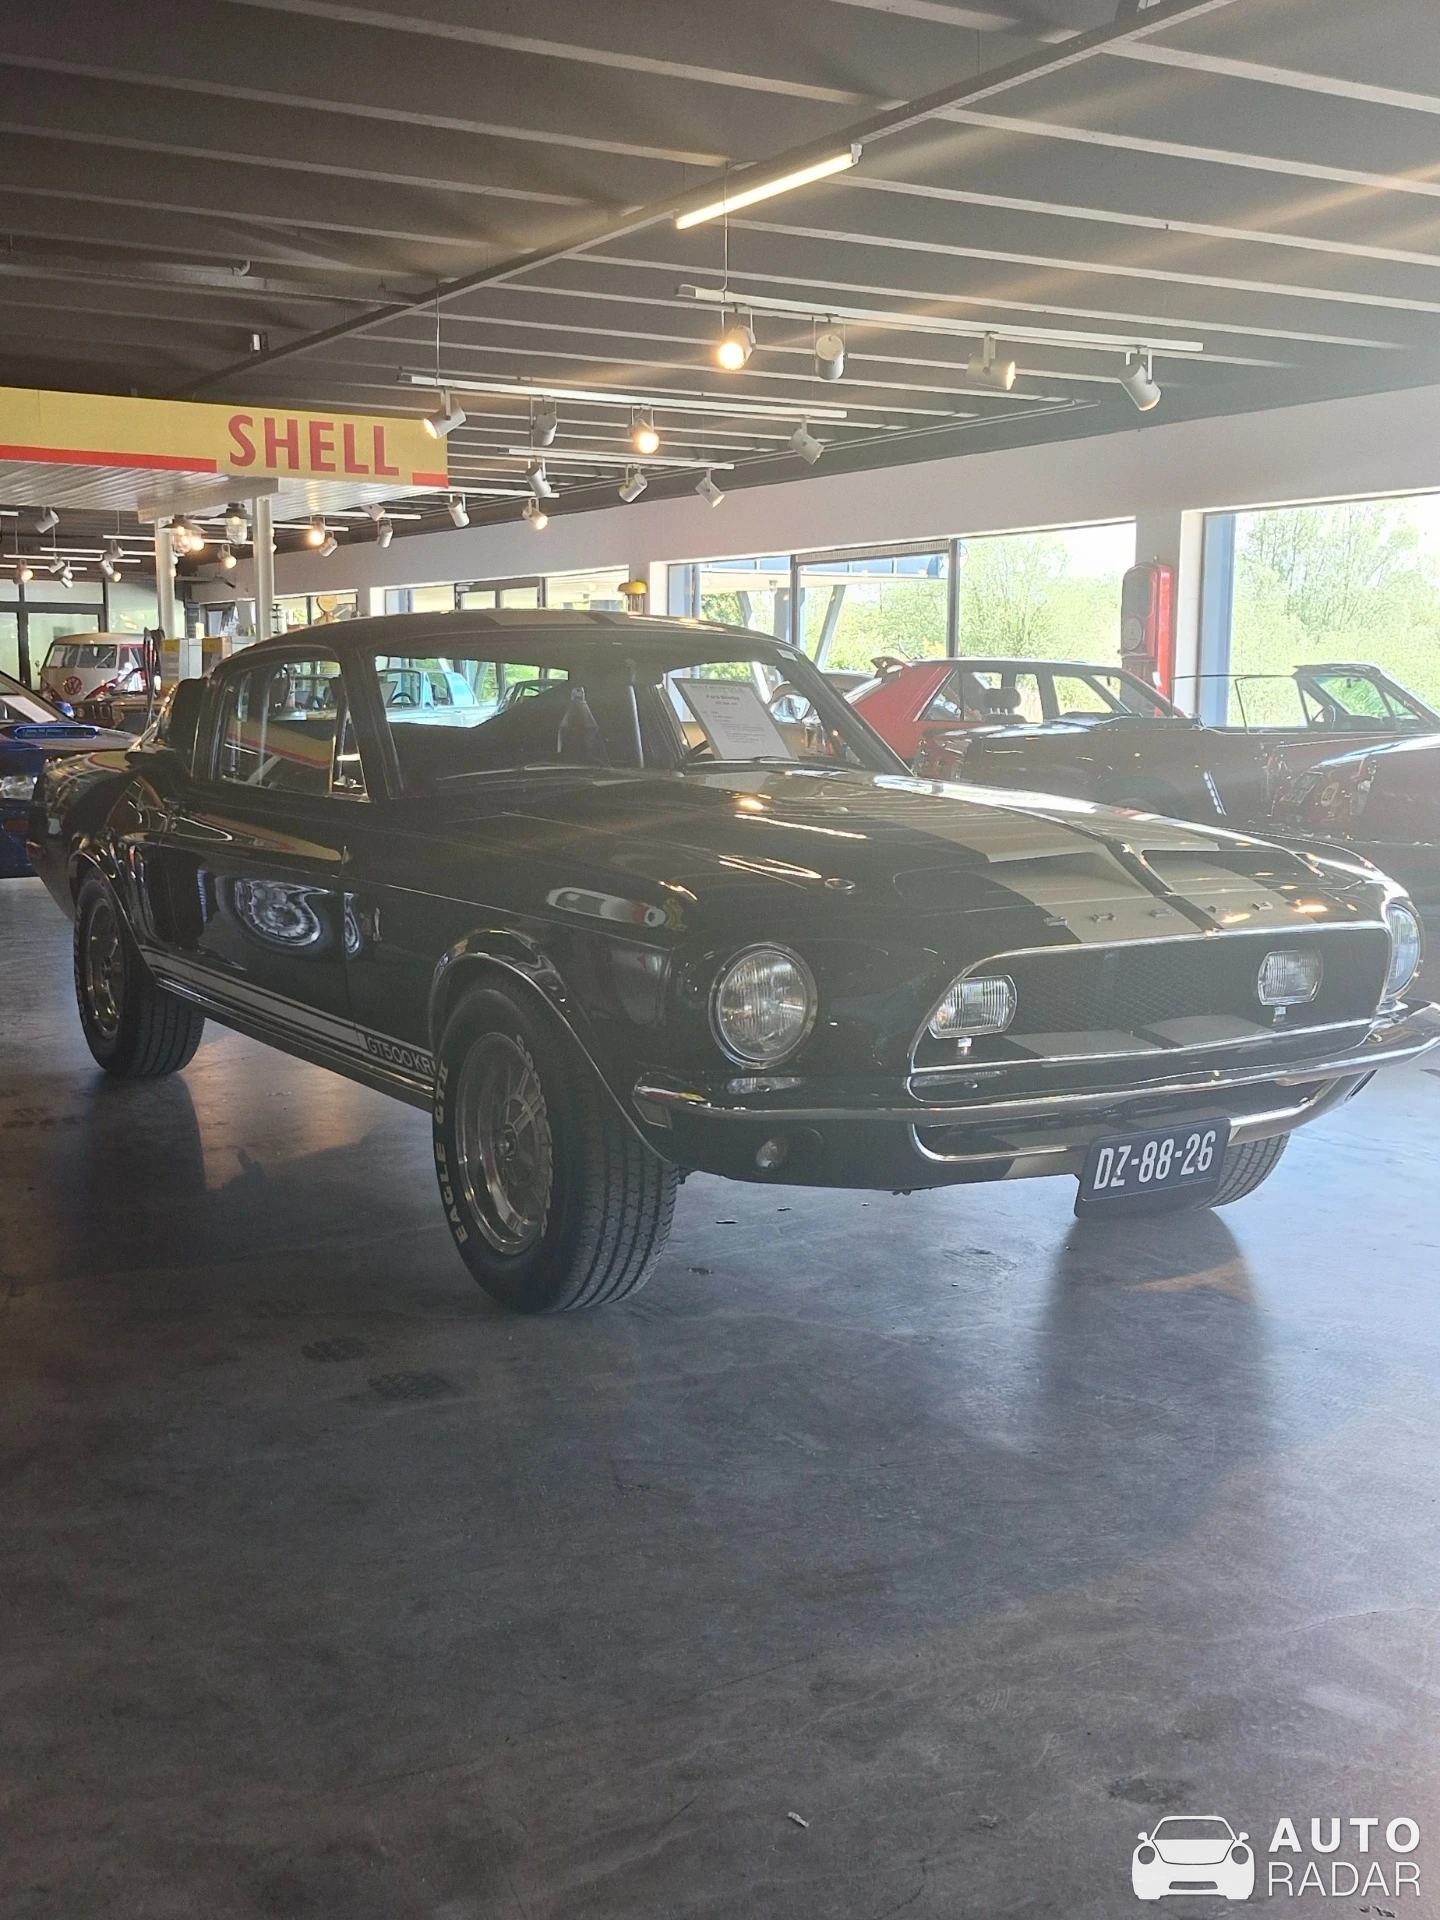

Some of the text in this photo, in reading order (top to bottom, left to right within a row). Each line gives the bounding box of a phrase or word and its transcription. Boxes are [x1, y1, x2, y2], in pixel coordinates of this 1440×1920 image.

[228, 415, 399, 476] SHELL
[64, 676, 82, 695] VW
[1093, 1131, 1217, 1190] DZ-88-26
[436, 1143, 468, 1243] EAGLE
